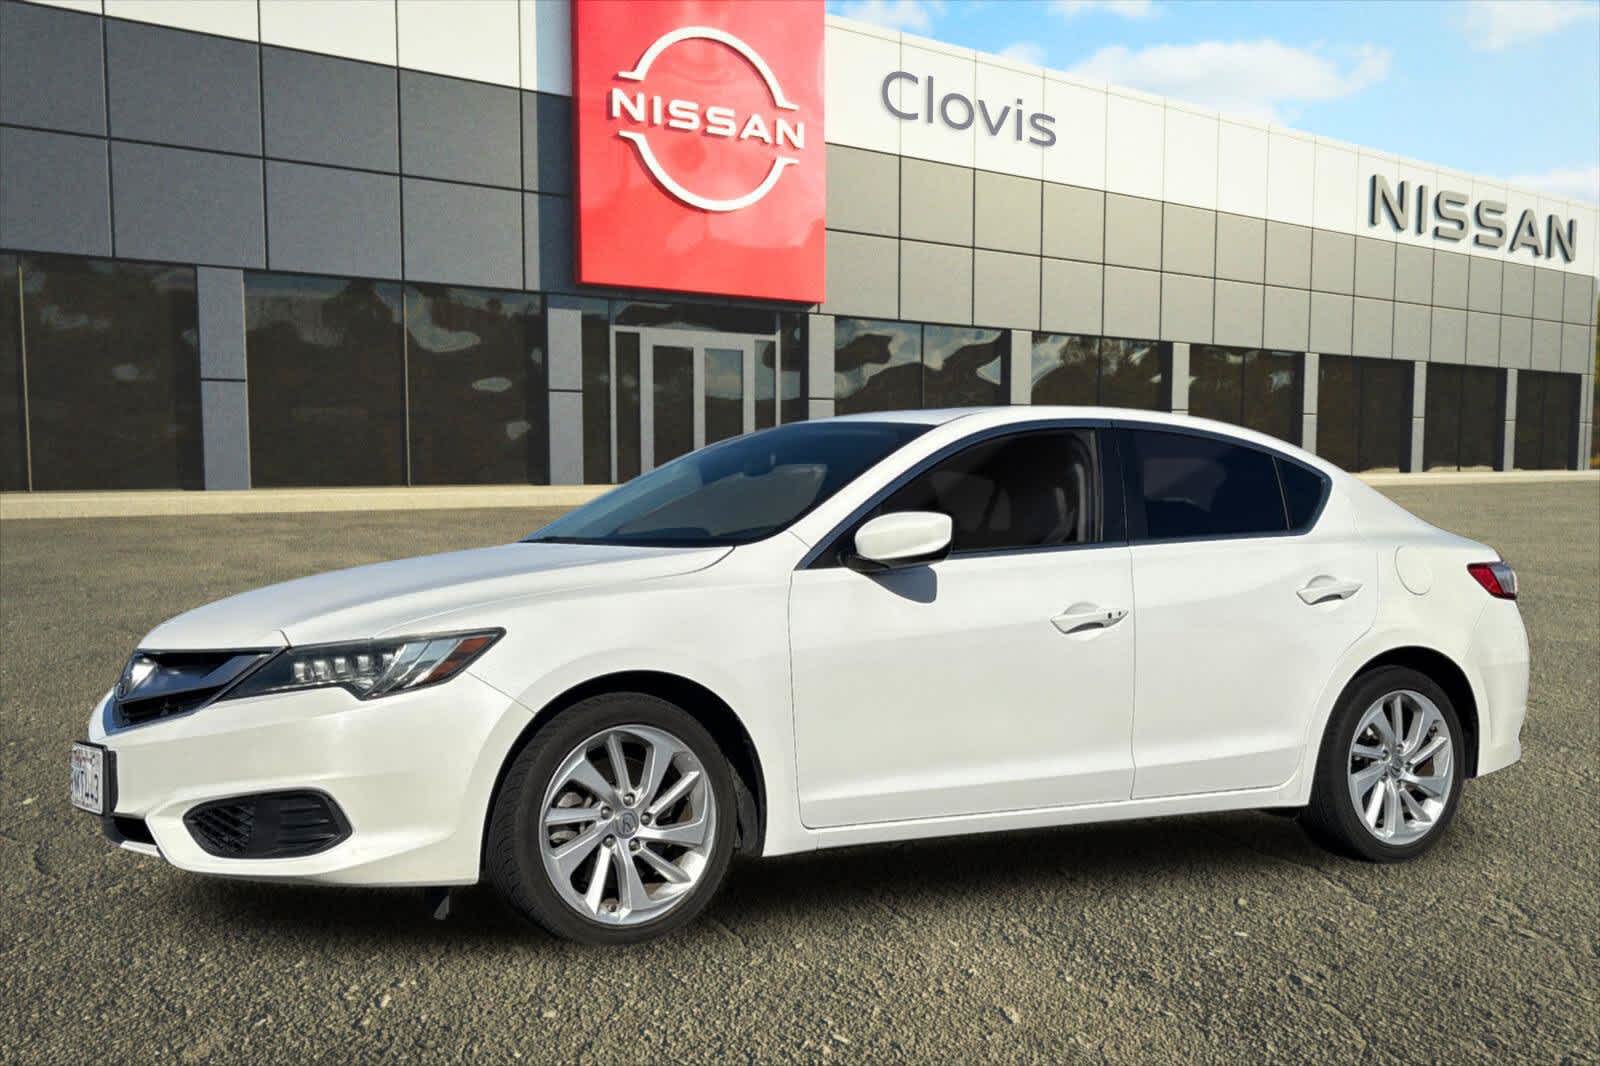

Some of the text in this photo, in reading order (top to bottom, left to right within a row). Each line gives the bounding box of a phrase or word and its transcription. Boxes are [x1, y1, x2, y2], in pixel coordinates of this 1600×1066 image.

[610, 87, 805, 150] NISSAN
[881, 70, 1057, 147] Clovis
[1369, 173, 1577, 263] NISSAN
